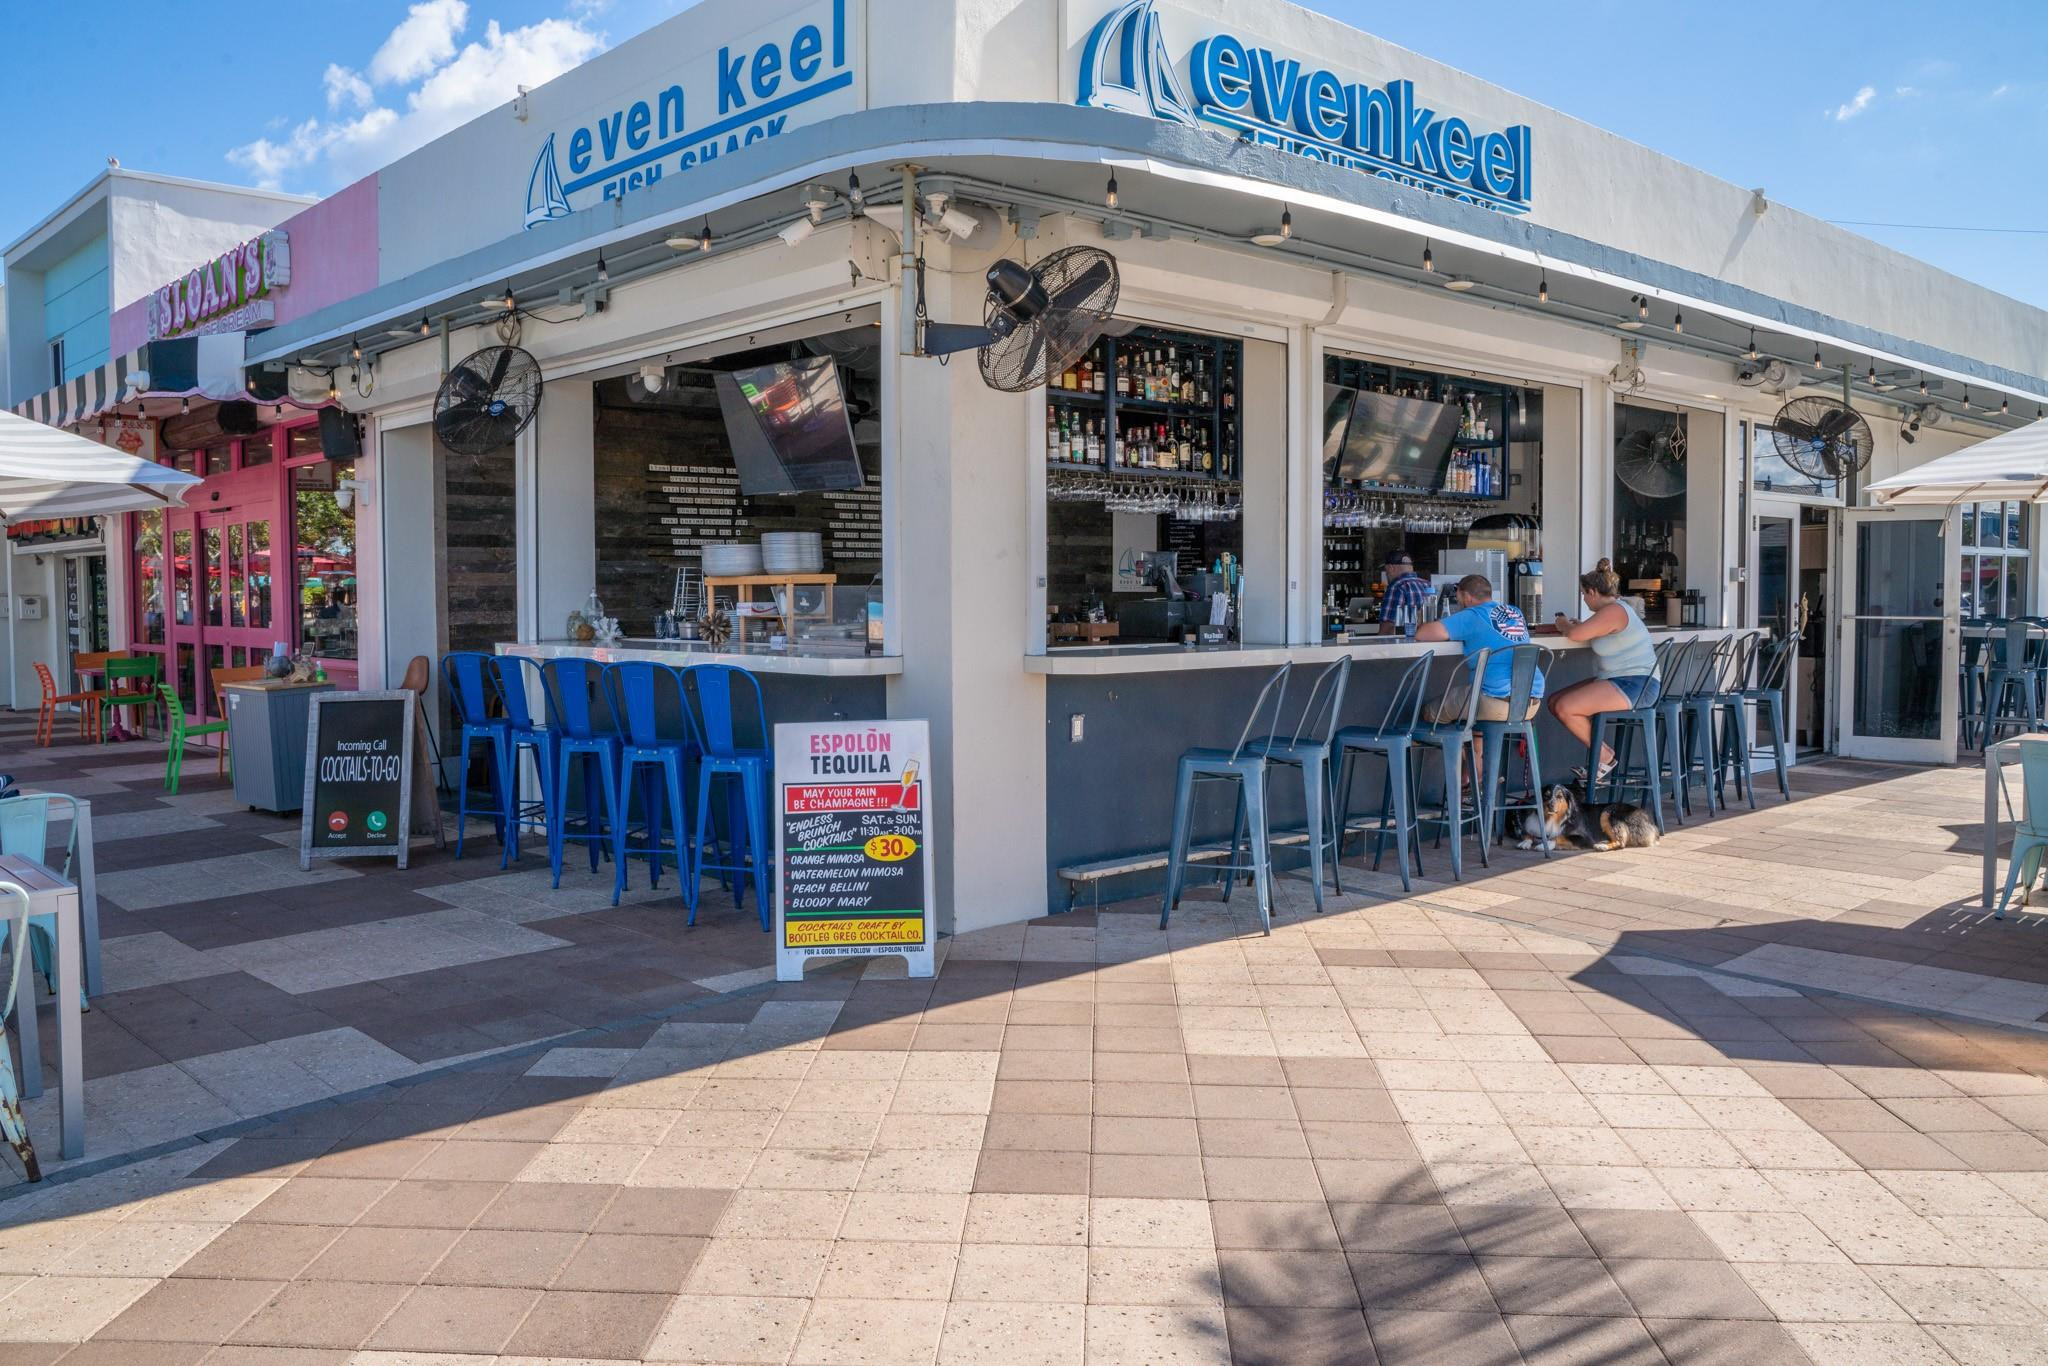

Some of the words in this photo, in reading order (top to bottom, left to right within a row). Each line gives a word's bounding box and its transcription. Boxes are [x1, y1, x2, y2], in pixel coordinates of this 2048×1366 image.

[569, 85, 684, 175] even
[718, 0, 845, 115] keel
[1197, 33, 1532, 202] evenkeel
[159, 238, 261, 337] SLOAN'S
[220, 302, 263, 332] CREAM
[337, 740, 371, 753] Incoming
[373, 739, 387, 750] Call
[321, 755, 399, 782] COCKTAILS-TO-GO
[810, 754, 891, 774] TEQUILA
[803, 788, 826, 799] MAY
[828, 788, 853, 798] YOUR
[855, 787, 877, 796] PAIN
[794, 799, 805, 809] BE
[810, 798, 875, 809] CHAMPAGNE
[895, 814, 920, 824] SUN.
[798, 821, 841, 841] BRUNCH
[791, 855, 825, 865] ORANGE
[827, 854, 864, 864] MIMOSA
[791, 868, 859, 880] WATERMELON
[861, 867, 904, 877] MIMOSA
[793, 883, 826, 893] PEACH
[830, 882, 869, 893] BELLINI
[793, 897, 834, 908] BLOODY
[837, 896, 872, 907] MARY
[798, 922, 853, 932] COCKTAILS
[857, 921, 888, 930] CRAFT
[891, 921, 905, 930] BY
[789, 932, 829, 943] BOOTLEG
[834, 931, 857, 941] GREG
[860, 930, 905, 940] COCKTAIL
